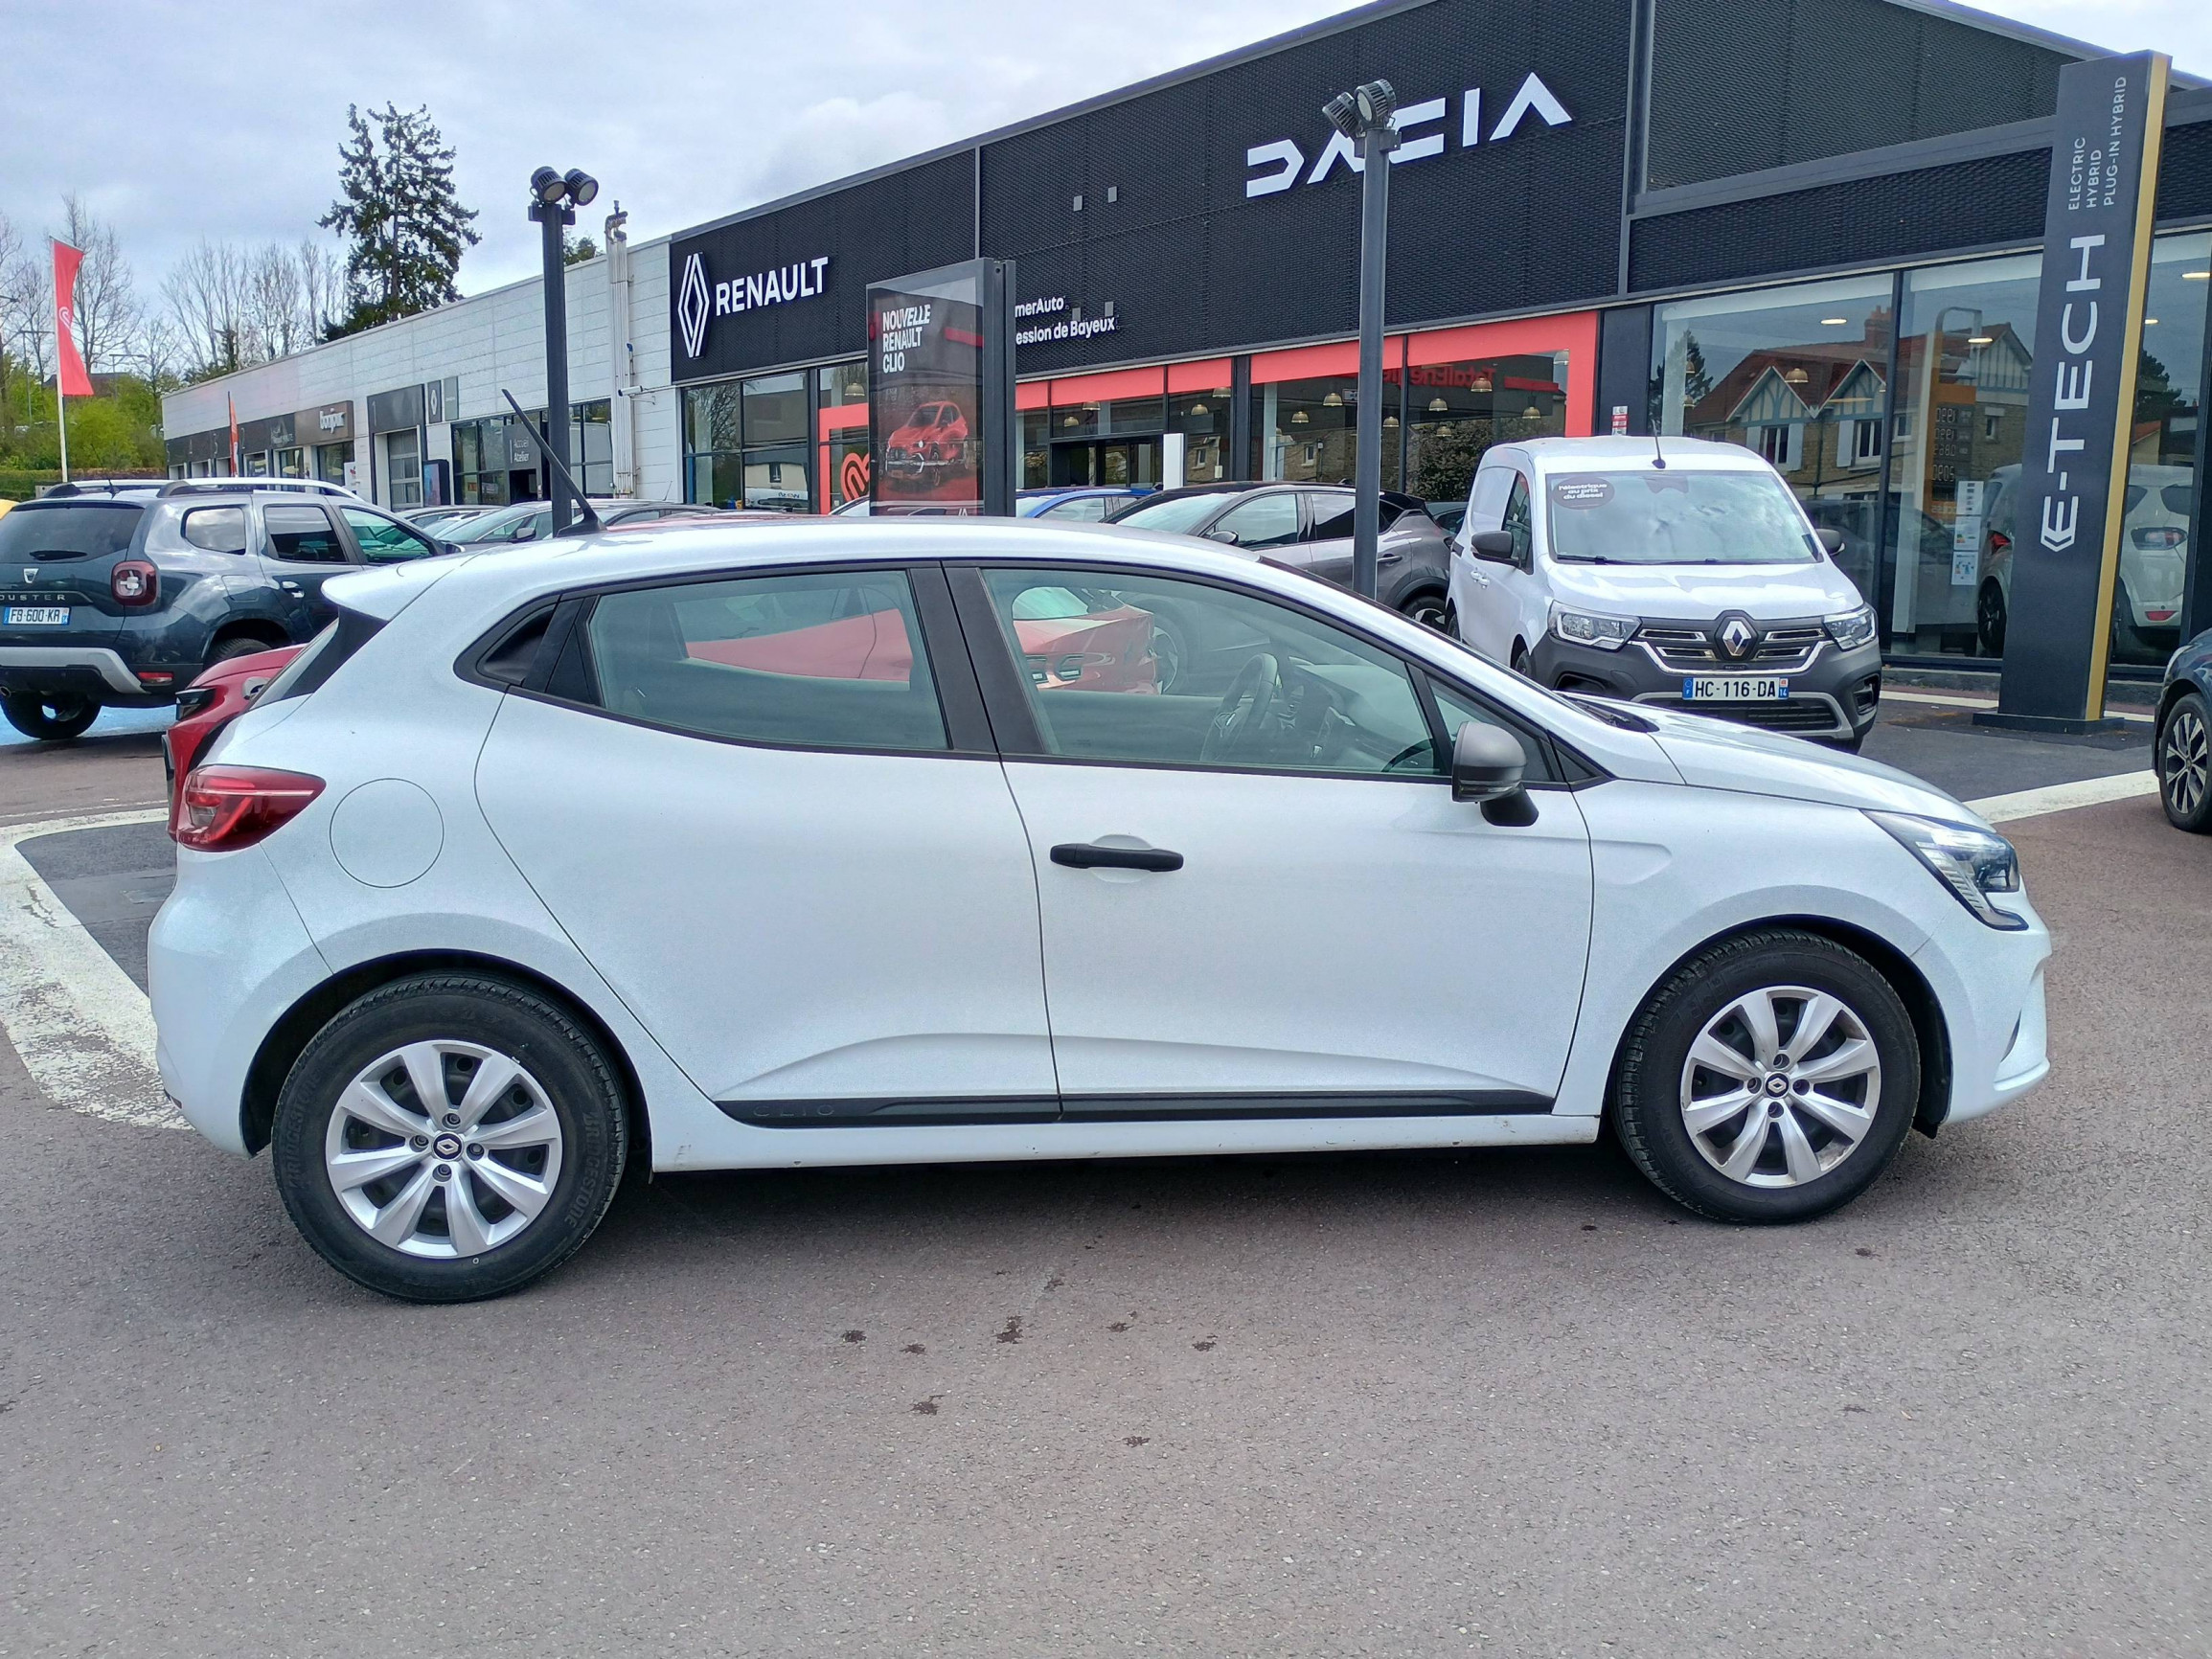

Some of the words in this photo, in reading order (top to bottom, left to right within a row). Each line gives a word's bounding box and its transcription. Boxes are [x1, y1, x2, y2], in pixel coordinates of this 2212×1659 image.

[2110, 77, 2127, 136] HYBRID
[1246, 72, 1573, 198] DACIA
[2068, 137, 2086, 211] ELECTRIC
[2087, 149, 2102, 208] HYBRID
[2104, 141, 2120, 206] PLUG-IN
[716, 256, 829, 317] RENAULT
[882, 304, 931, 331] NOUVELLE
[1054, 322, 1068, 339] de
[1070, 317, 1115, 339] Bayeux
[882, 327, 923, 352] RENAULT
[882, 352, 905, 374] CLIO
[2040, 234, 2106, 553] E-TECH
[1695, 681, 1776, 697] HC-116-DA
[1779, 688, 1788, 696] 14
[753, 1103, 834, 1117] CLIO
